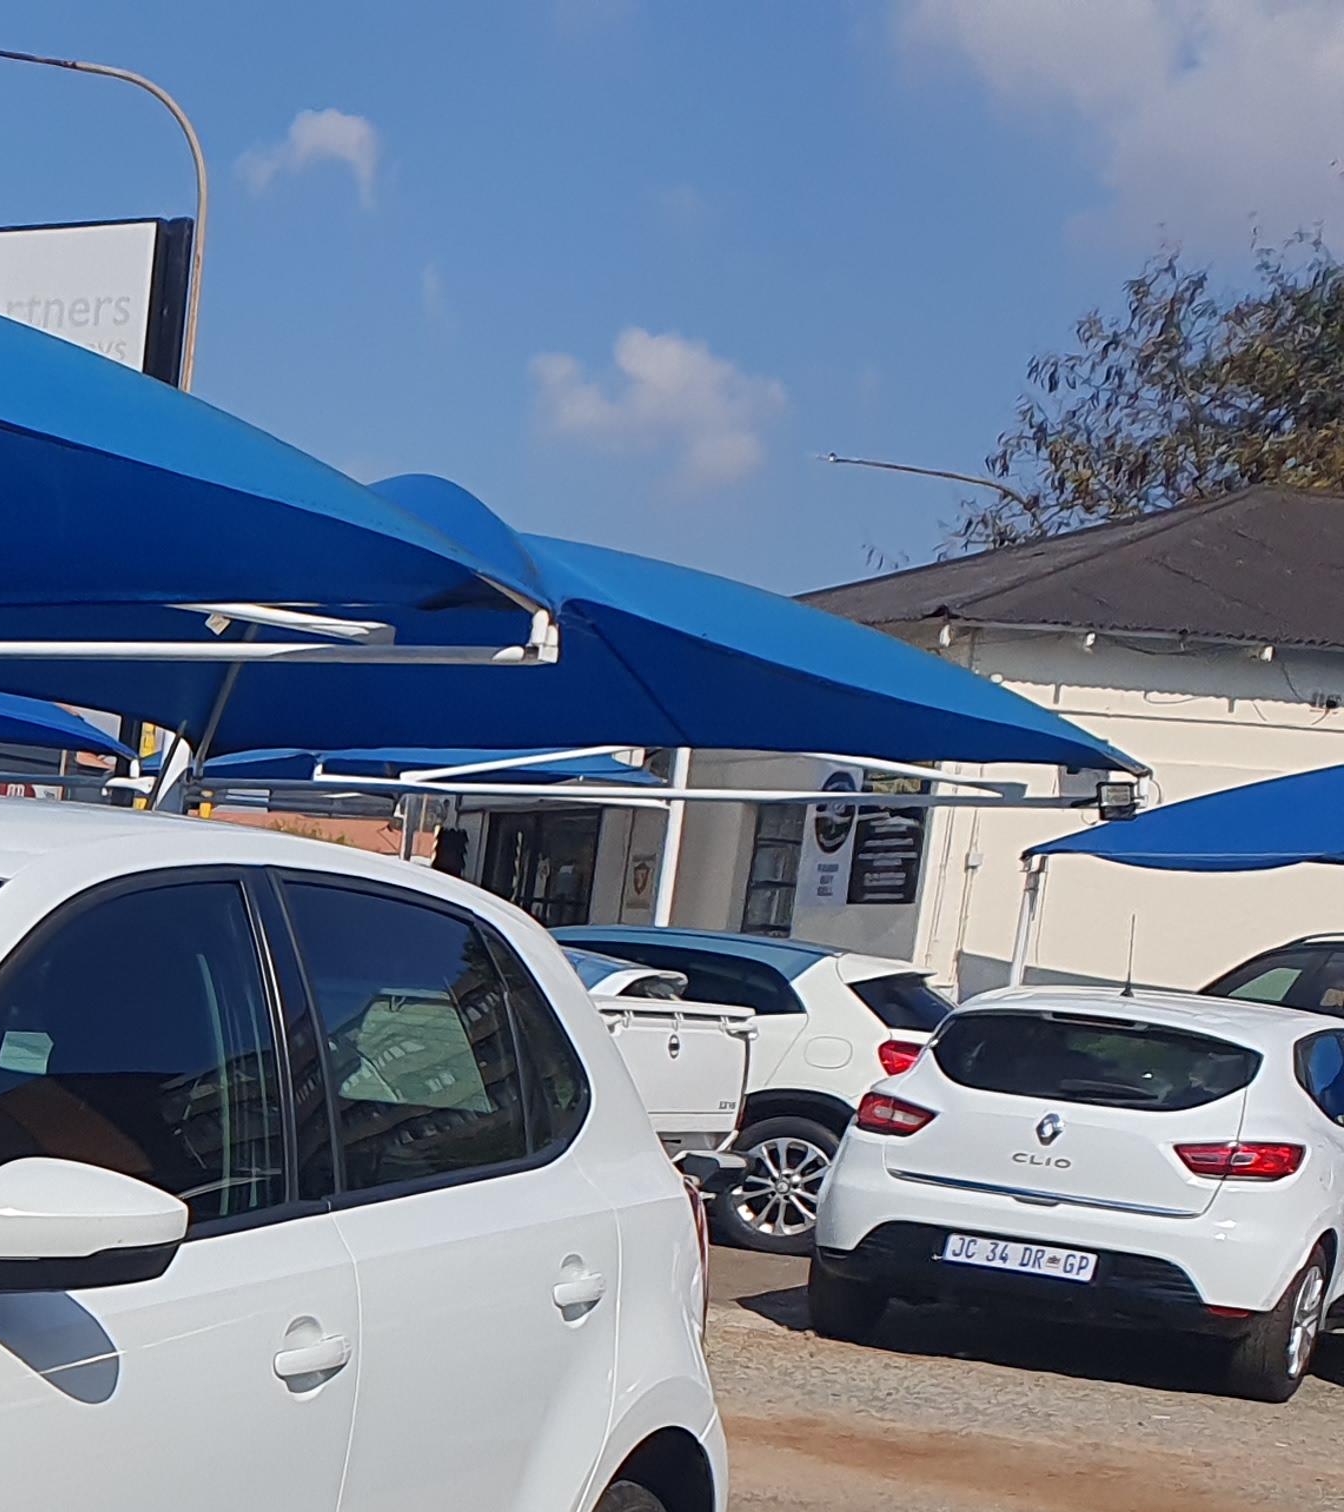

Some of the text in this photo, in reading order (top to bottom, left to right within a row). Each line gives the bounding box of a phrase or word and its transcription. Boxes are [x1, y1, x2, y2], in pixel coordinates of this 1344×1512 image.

[1011, 1152, 1072, 1169] CLIO
[952, 1237, 1090, 1276] JC 34 DR GP
